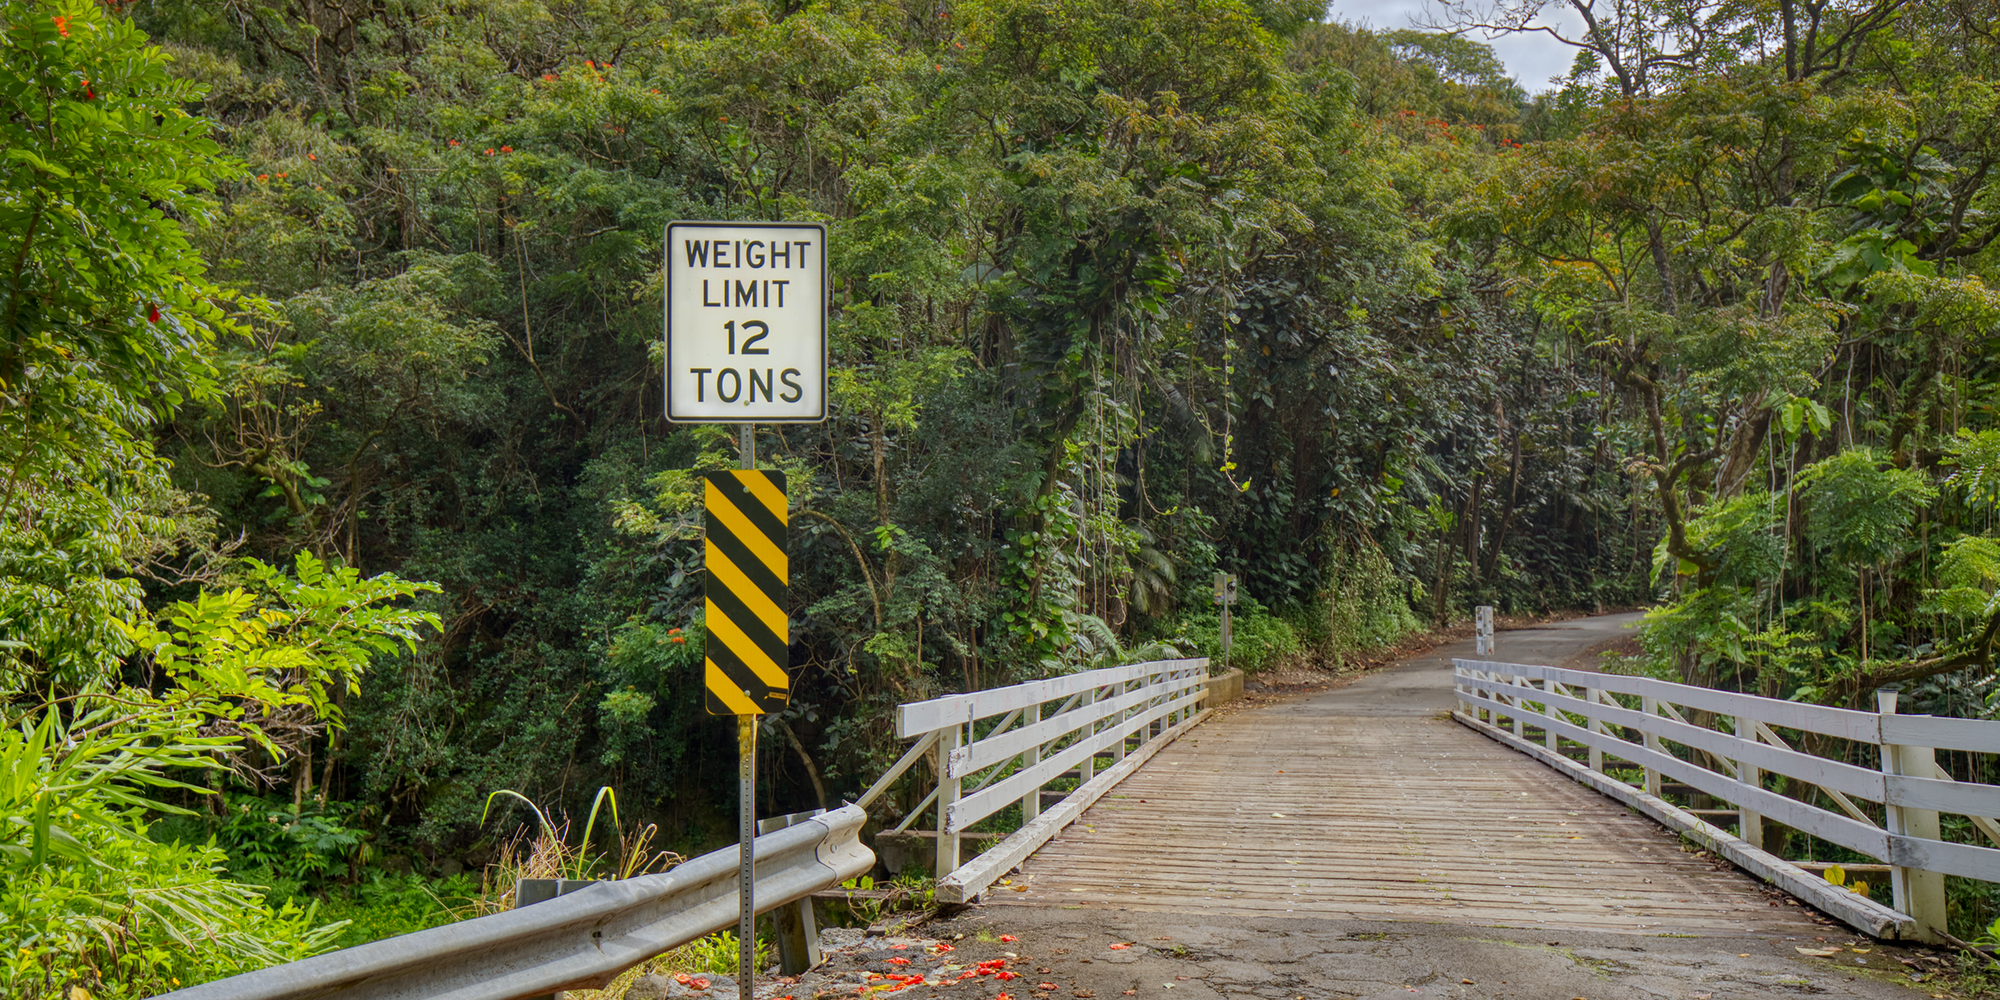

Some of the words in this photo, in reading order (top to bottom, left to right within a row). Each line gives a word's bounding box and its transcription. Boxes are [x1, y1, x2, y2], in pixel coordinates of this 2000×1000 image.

[685, 240, 811, 269] WEIGHT
[703, 279, 790, 308] LIMIT
[723, 320, 770, 355] 12
[690, 368, 803, 403] TONS
